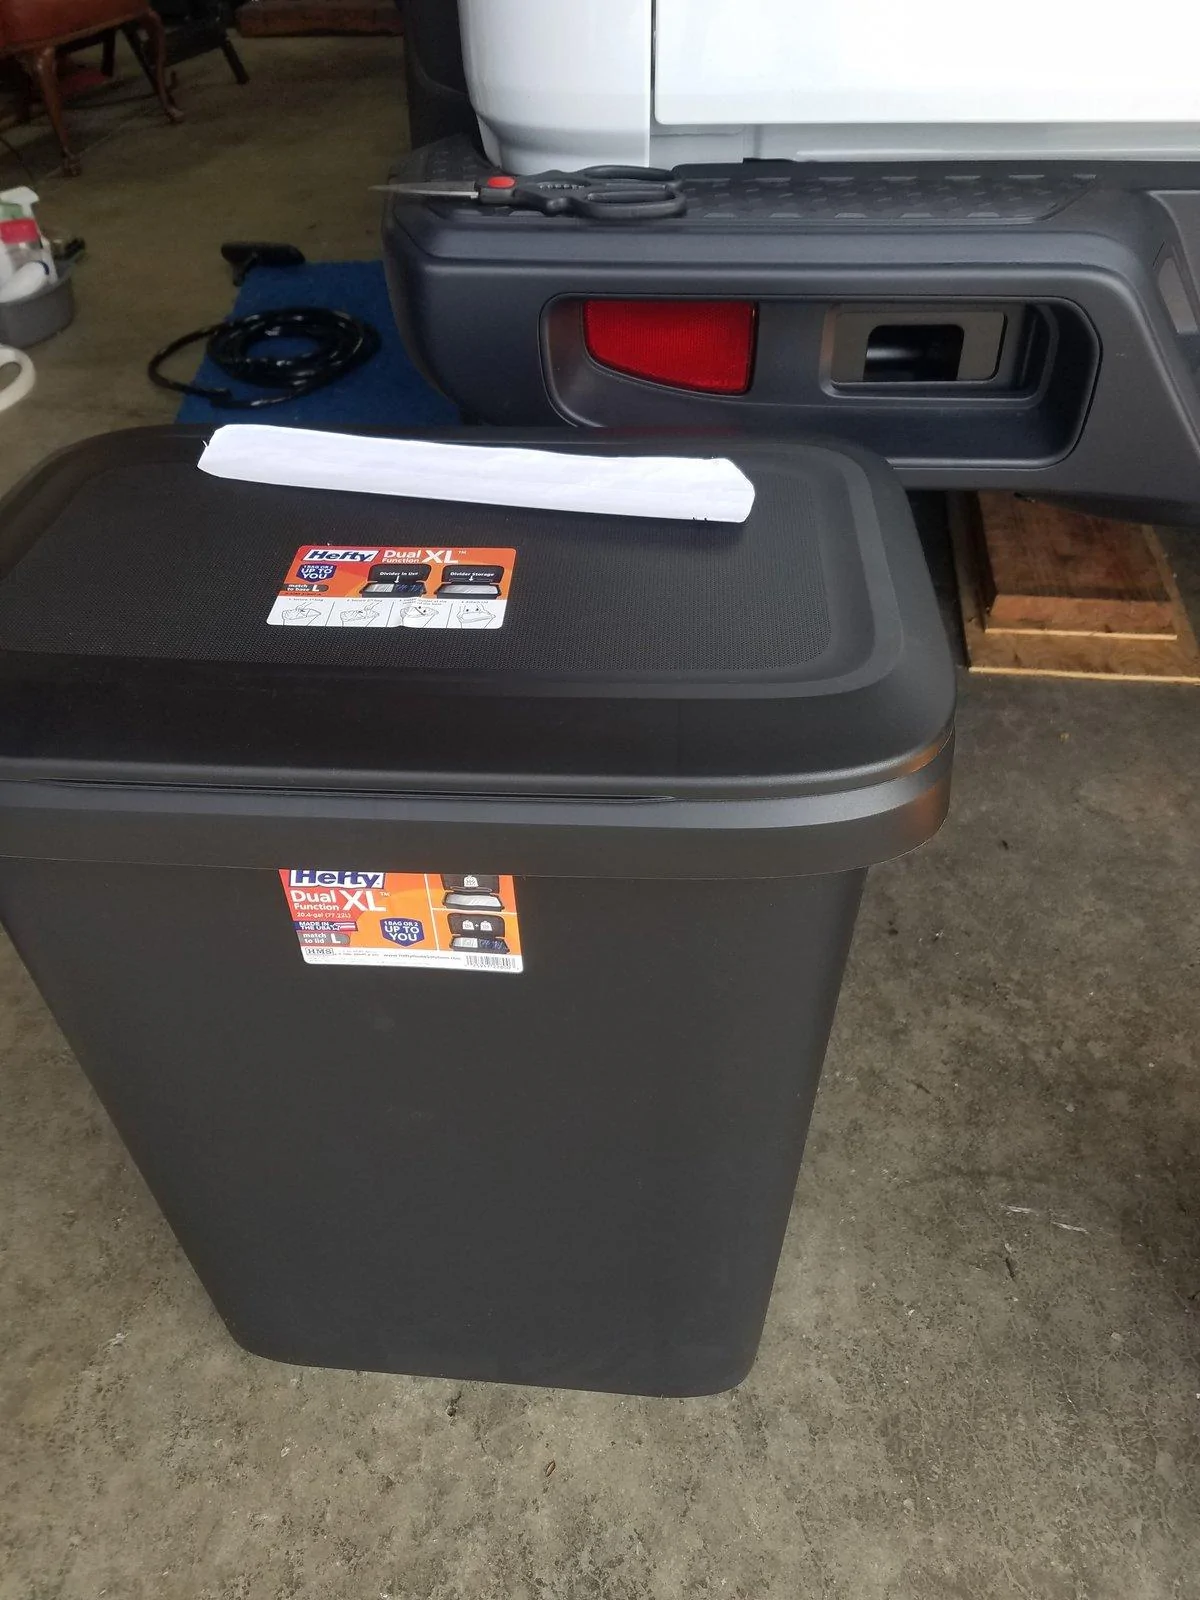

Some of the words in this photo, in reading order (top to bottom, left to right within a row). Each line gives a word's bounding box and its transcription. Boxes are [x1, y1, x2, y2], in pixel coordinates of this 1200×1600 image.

[308, 551, 374, 562] Hefty
[383, 550, 421, 558] Dual
[422, 550, 458, 563] XL
[290, 890, 337, 903] Dual
[339, 890, 387, 912] XL
[293, 903, 340, 911] Function
[402, 926, 420, 934] TO
[330, 933, 341, 944] L
[389, 932, 418, 941] YOU
